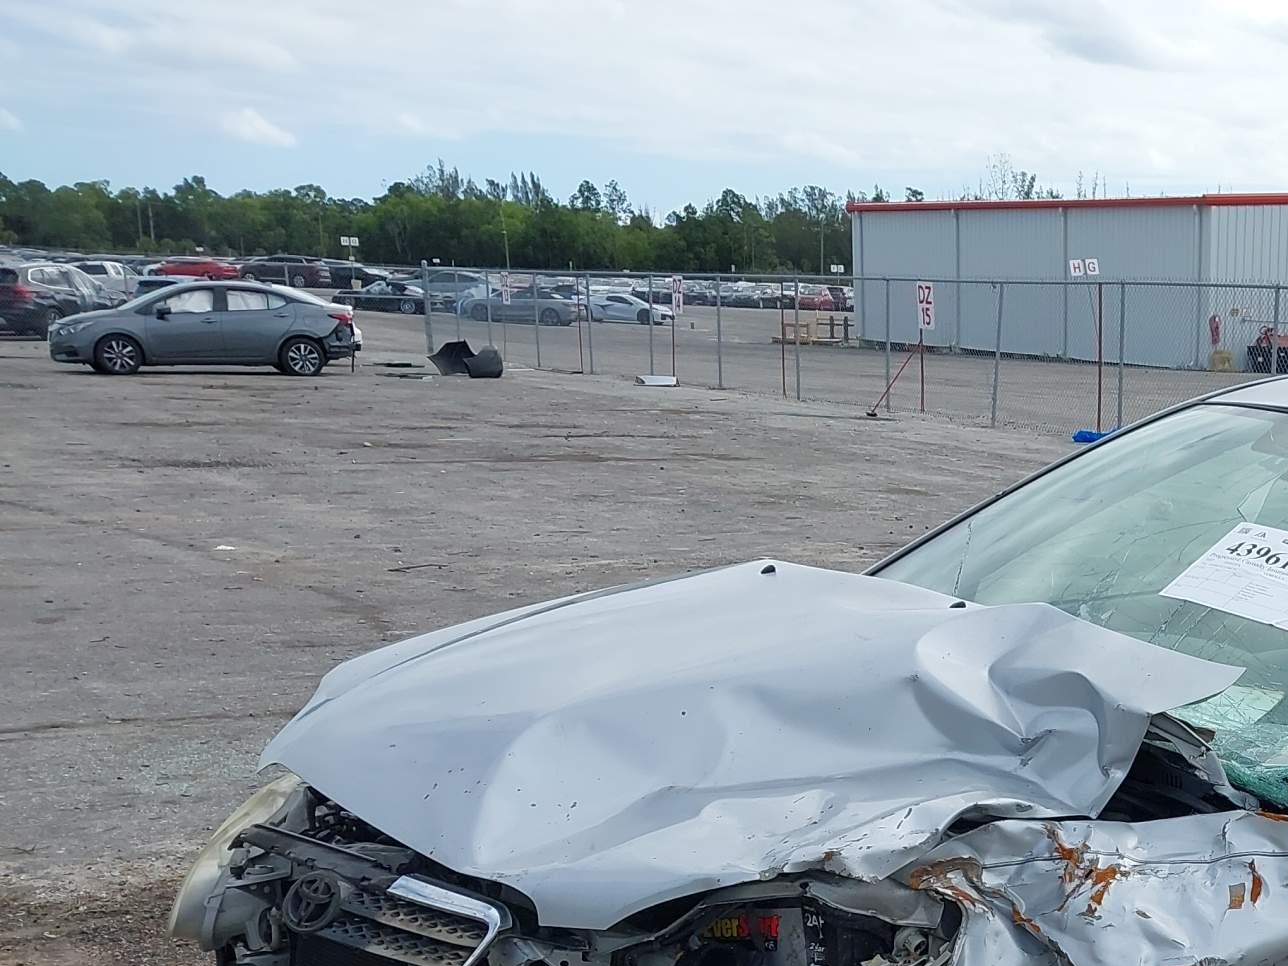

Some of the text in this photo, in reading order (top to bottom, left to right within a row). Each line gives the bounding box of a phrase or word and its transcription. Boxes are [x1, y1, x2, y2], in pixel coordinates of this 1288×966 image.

[1072, 261, 1096, 273] H G
[672, 278, 682, 294] DZ
[918, 286, 932, 304] DZ
[921, 307, 932, 326] 15
